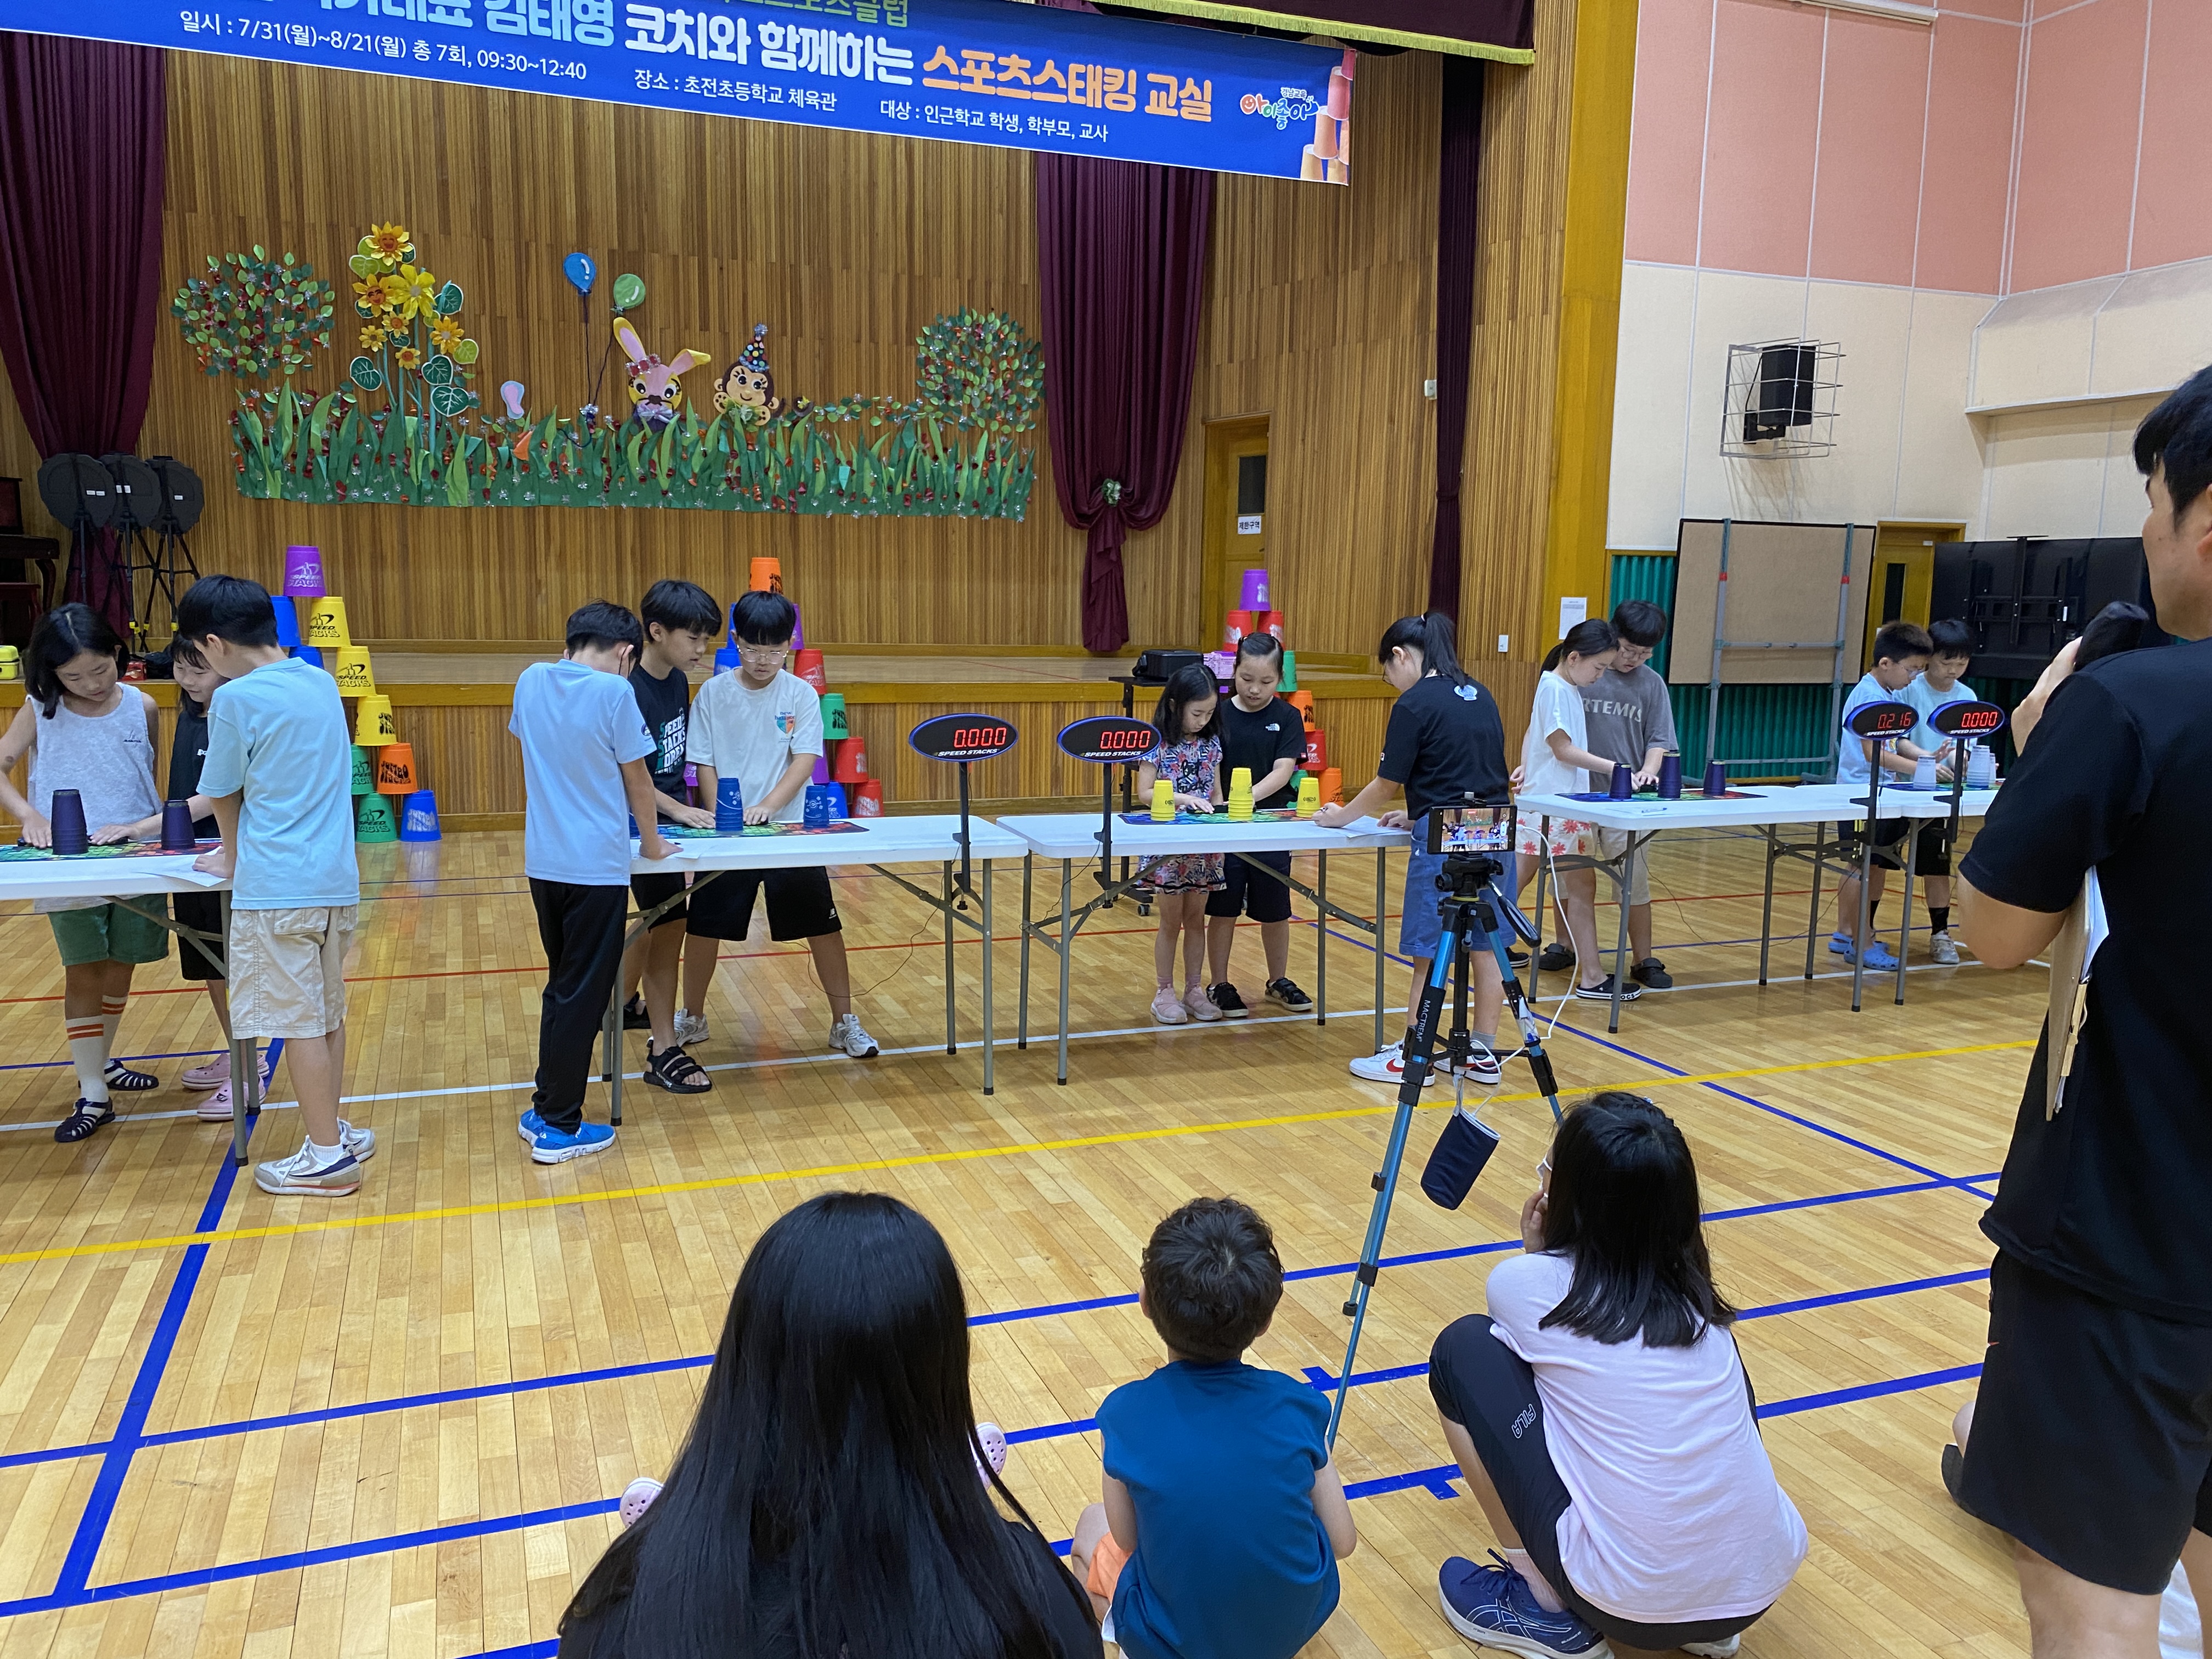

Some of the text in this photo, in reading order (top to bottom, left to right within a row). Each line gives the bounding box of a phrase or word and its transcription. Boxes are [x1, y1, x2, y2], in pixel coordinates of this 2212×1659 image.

[179, 10, 221, 36] 일시
[238, 18, 407, 59] 7/31(월)~8/21(월)
[412, 40, 431, 61] 총
[436, 43, 472, 68] 7회,
[477, 49, 587, 80] 09:30~12:40
[484, 0, 614, 47] 김태영
[625, 3, 752, 65] 코치와
[758, 21, 915, 86] 함께하는
[922, 45, 1137, 112] 스포츠스태킹
[1144, 72, 1212, 122] 교실
[634, 69, 670, 91] 장소
[684, 75, 784, 105] 초전초등학교
[788, 88, 838, 112] 체육관
[1280, 87, 1307, 100] 경남교육
[880, 100, 911, 120] 대상
[924, 104, 986, 128] 인근학교
[988, 111, 1023, 134] 학생,
[1027, 116, 1075, 139] 학부모,
[1079, 123, 1108, 143] 교사
[1240, 93, 1319, 131] 아이좋아
[1238, 521, 1260, 530] 제한구역
[1582, 698, 1642, 723] RTEMIS
[954, 727, 1007, 748] 0.000
[967, 748, 998, 756] STACKS
[1100, 730, 1151, 749] 0.000
[1415, 1000, 1431, 1040] MACTREM
[1511, 1403, 1536, 1438] FILA
